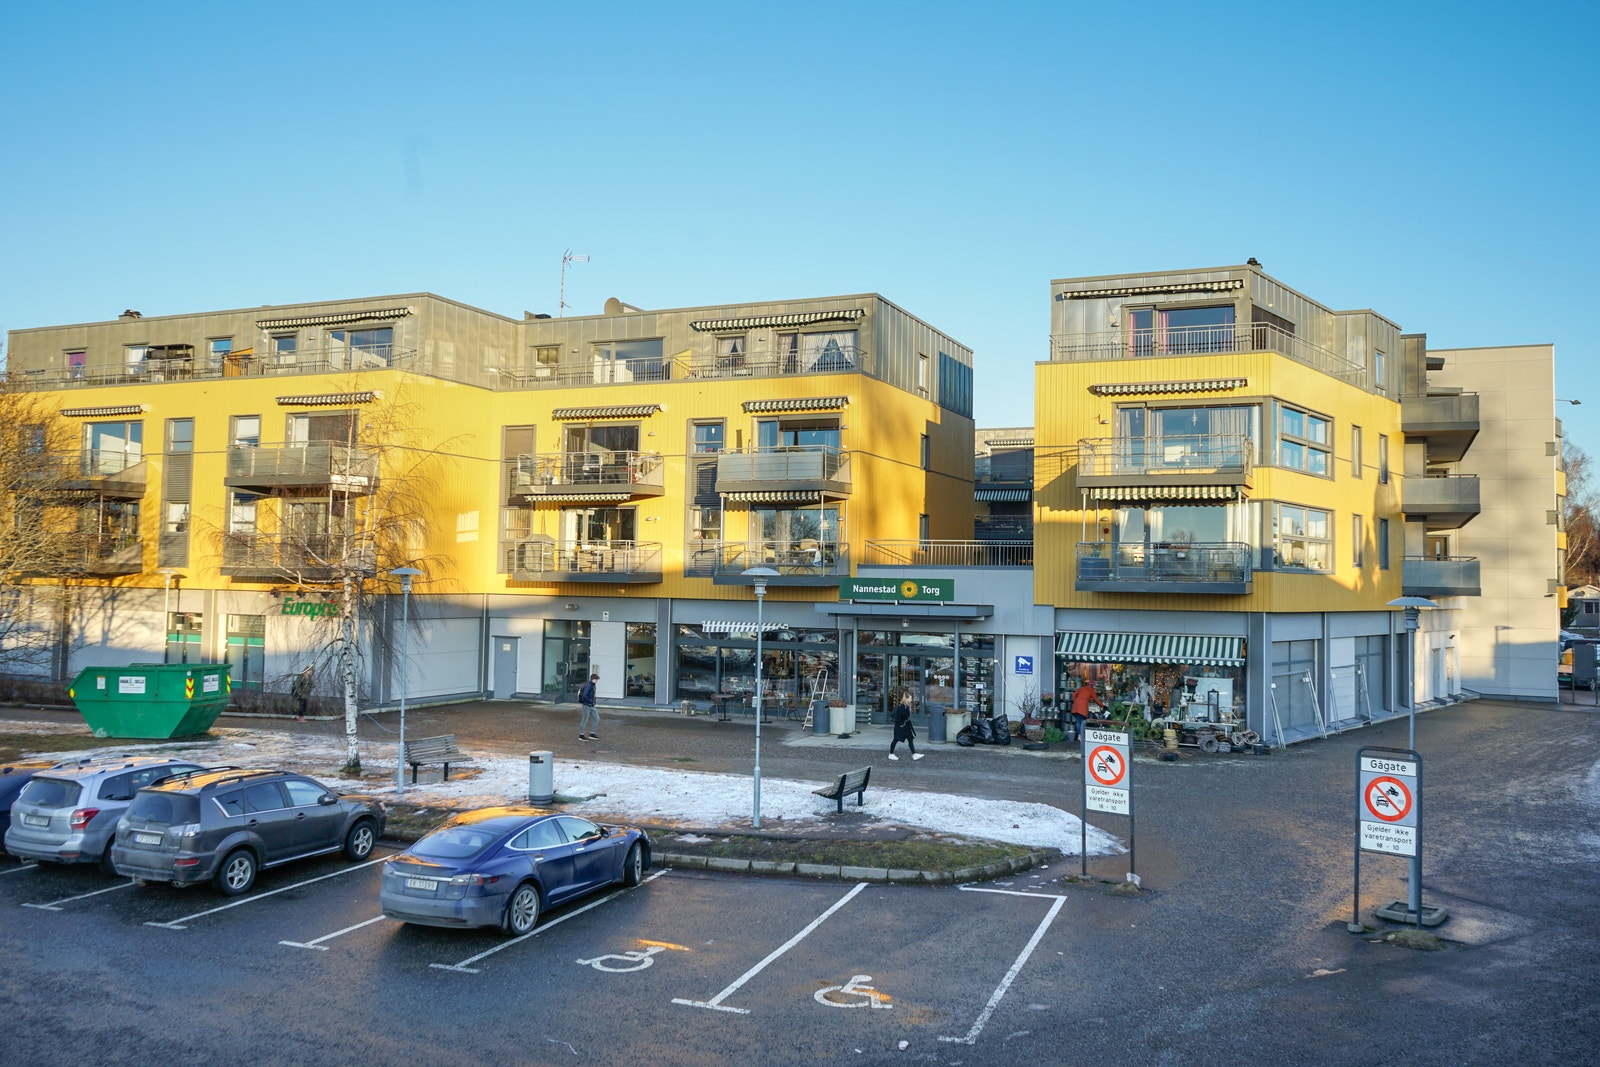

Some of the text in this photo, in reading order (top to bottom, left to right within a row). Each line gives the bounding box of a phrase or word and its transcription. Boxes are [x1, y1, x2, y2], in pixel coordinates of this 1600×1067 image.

[852, 585, 940, 596] Nannestad Torg
[1092, 731, 1121, 742] Gågate
[1370, 759, 1407, 772] Gågate
[1090, 788, 1110, 797] Gjelder
[1089, 795, 1126, 805] varetransport
[1367, 824, 1409, 836] Gjelder ikke
[1364, 833, 1412, 845] varetransport
